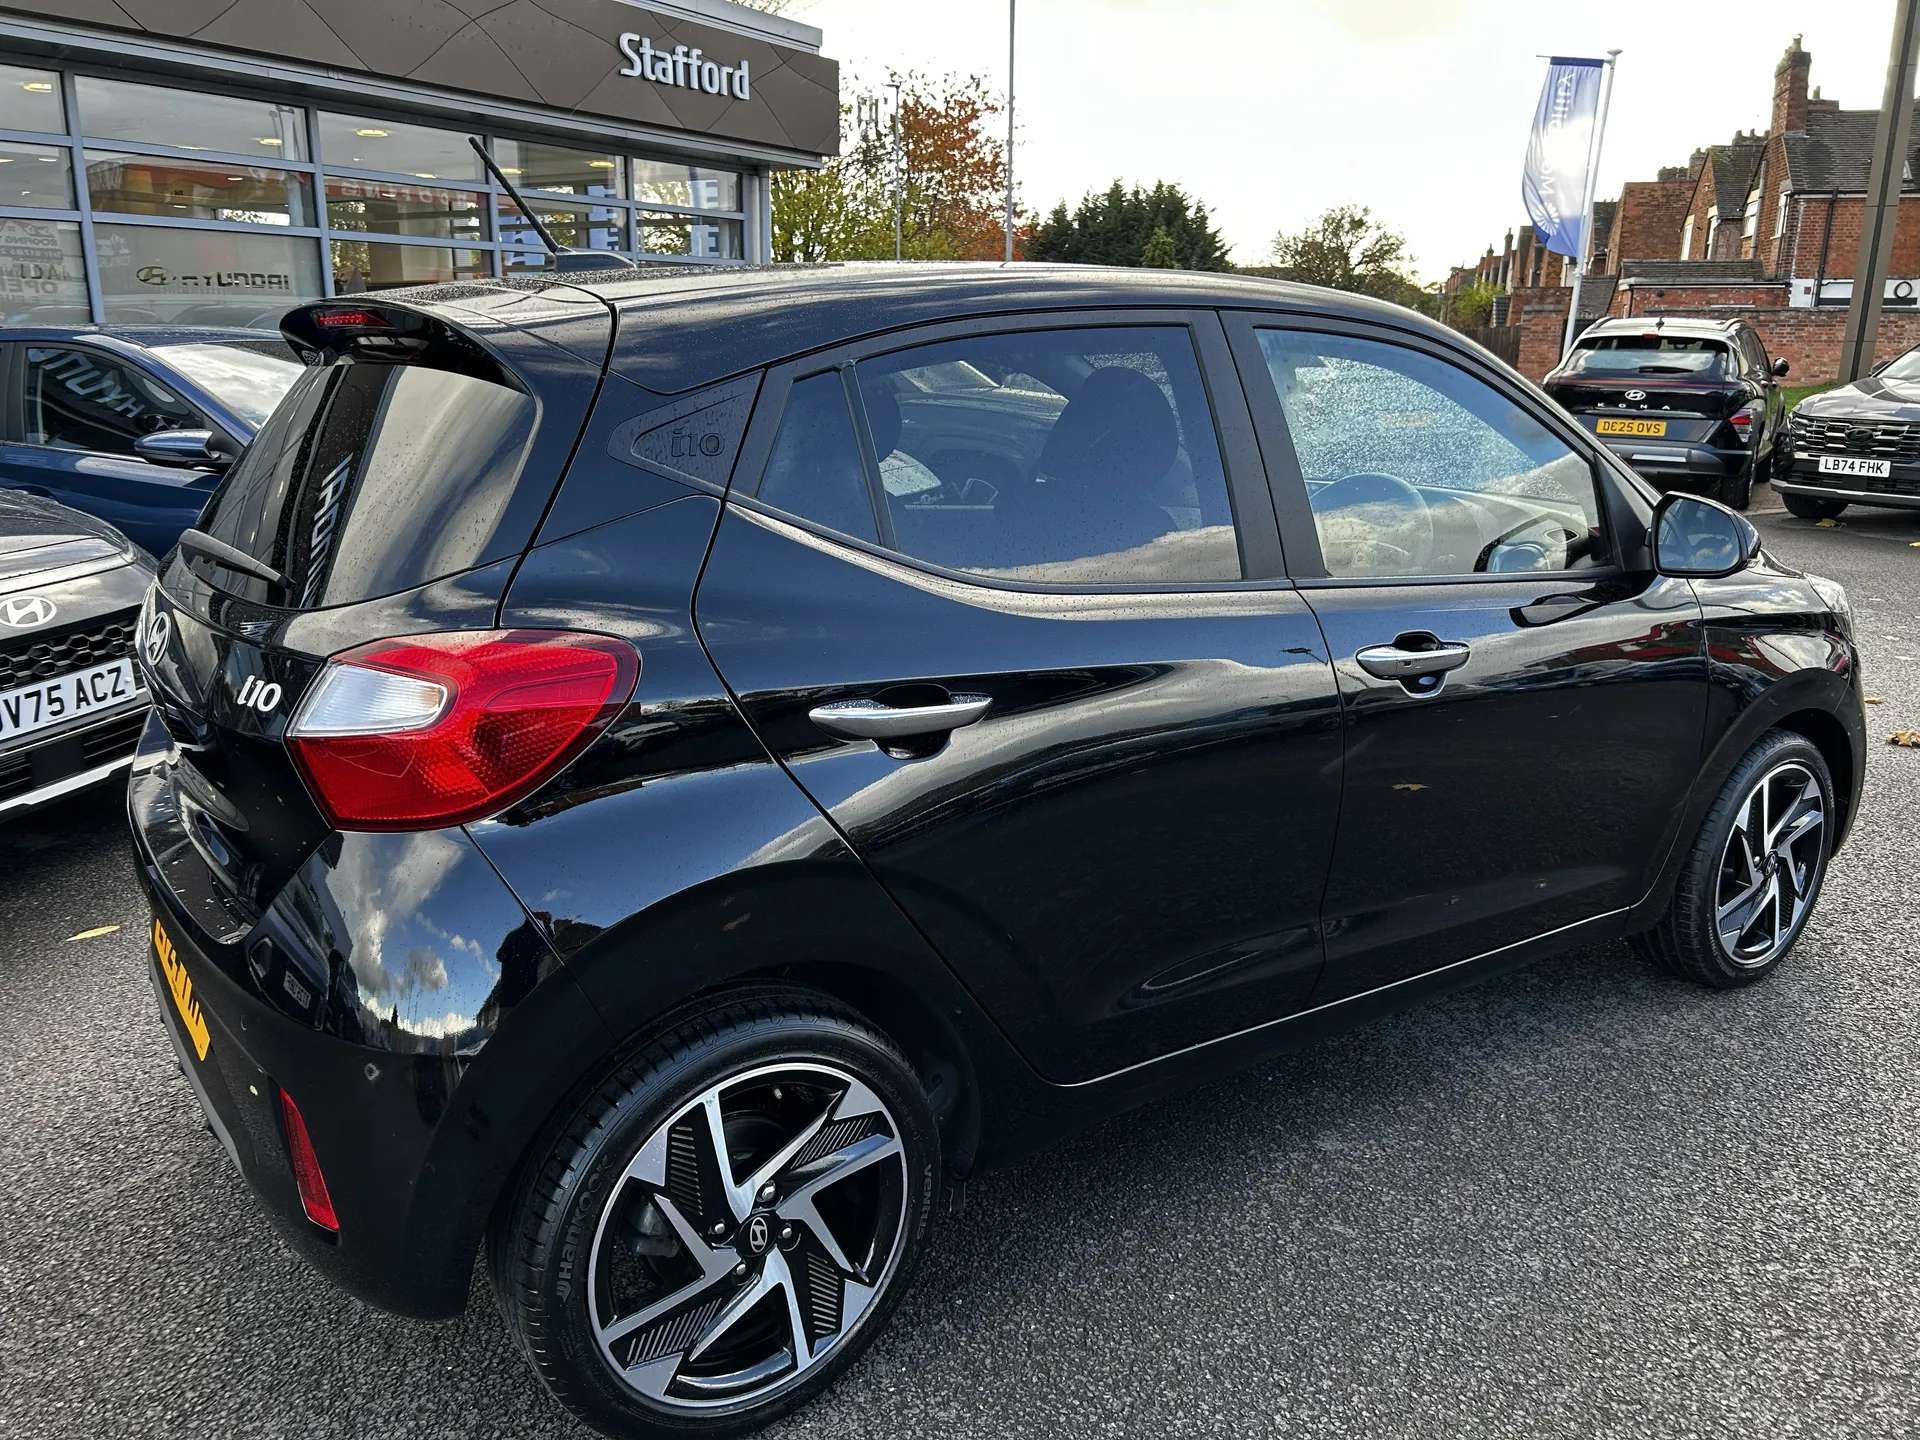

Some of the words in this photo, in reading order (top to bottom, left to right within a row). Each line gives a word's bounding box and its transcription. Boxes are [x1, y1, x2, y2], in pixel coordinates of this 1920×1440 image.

[619, 32, 750, 100] Stafford
[1597, 402, 1670, 410] KONA
[1602, 421, 1634, 433] DE25
[1636, 422, 1660, 434] OVS
[1824, 458, 1855, 472] LB74
[1858, 460, 1885, 474] FHK
[0, 682, 65, 733] V75
[76, 666, 126, 709] ACZ
